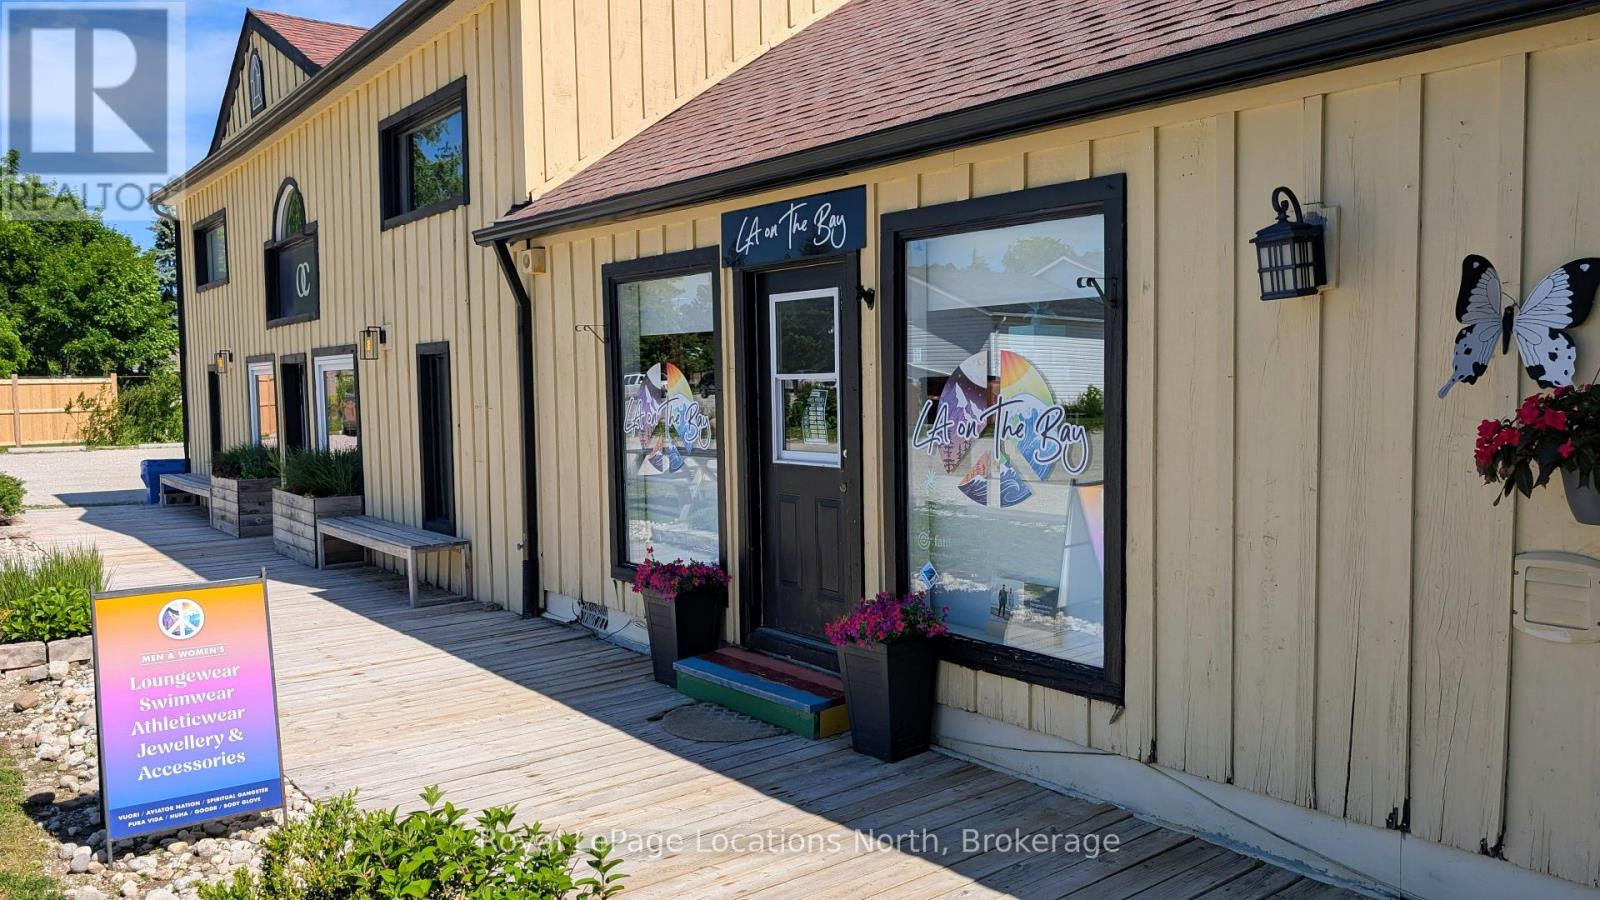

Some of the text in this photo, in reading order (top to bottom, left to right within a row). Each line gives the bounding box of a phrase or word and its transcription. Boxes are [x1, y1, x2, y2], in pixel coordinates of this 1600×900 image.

[764, 223, 778, 239] on
[778, 202, 808, 250] The
[813, 202, 847, 249] Bay
[647, 410, 659, 426] on
[658, 394, 681, 441] The
[684, 400, 712, 450] Bay
[956, 418, 981, 441] on
[979, 395, 1026, 461] The
[1032, 404, 1090, 476] Bay
[142, 645, 225, 663] MEN & WOMEN'S
[129, 665, 240, 691] Loungewear
[139, 687, 235, 712] Swimwear
[131, 707, 246, 736] Athleticwear
[137, 727, 244, 758] Jewellery &
[137, 751, 246, 781] Accessories
[118, 812, 140, 821] VUORI
[146, 805, 174, 815] AVIATOR
[175, 801, 200, 810] NATION
[206, 793, 236, 804] SPIRITUAL
[128, 819, 146, 828] PURA
[147, 816, 164, 824] VIDA
[223, 801, 240, 809] BODY
[241, 796, 261, 806] GLOVE
